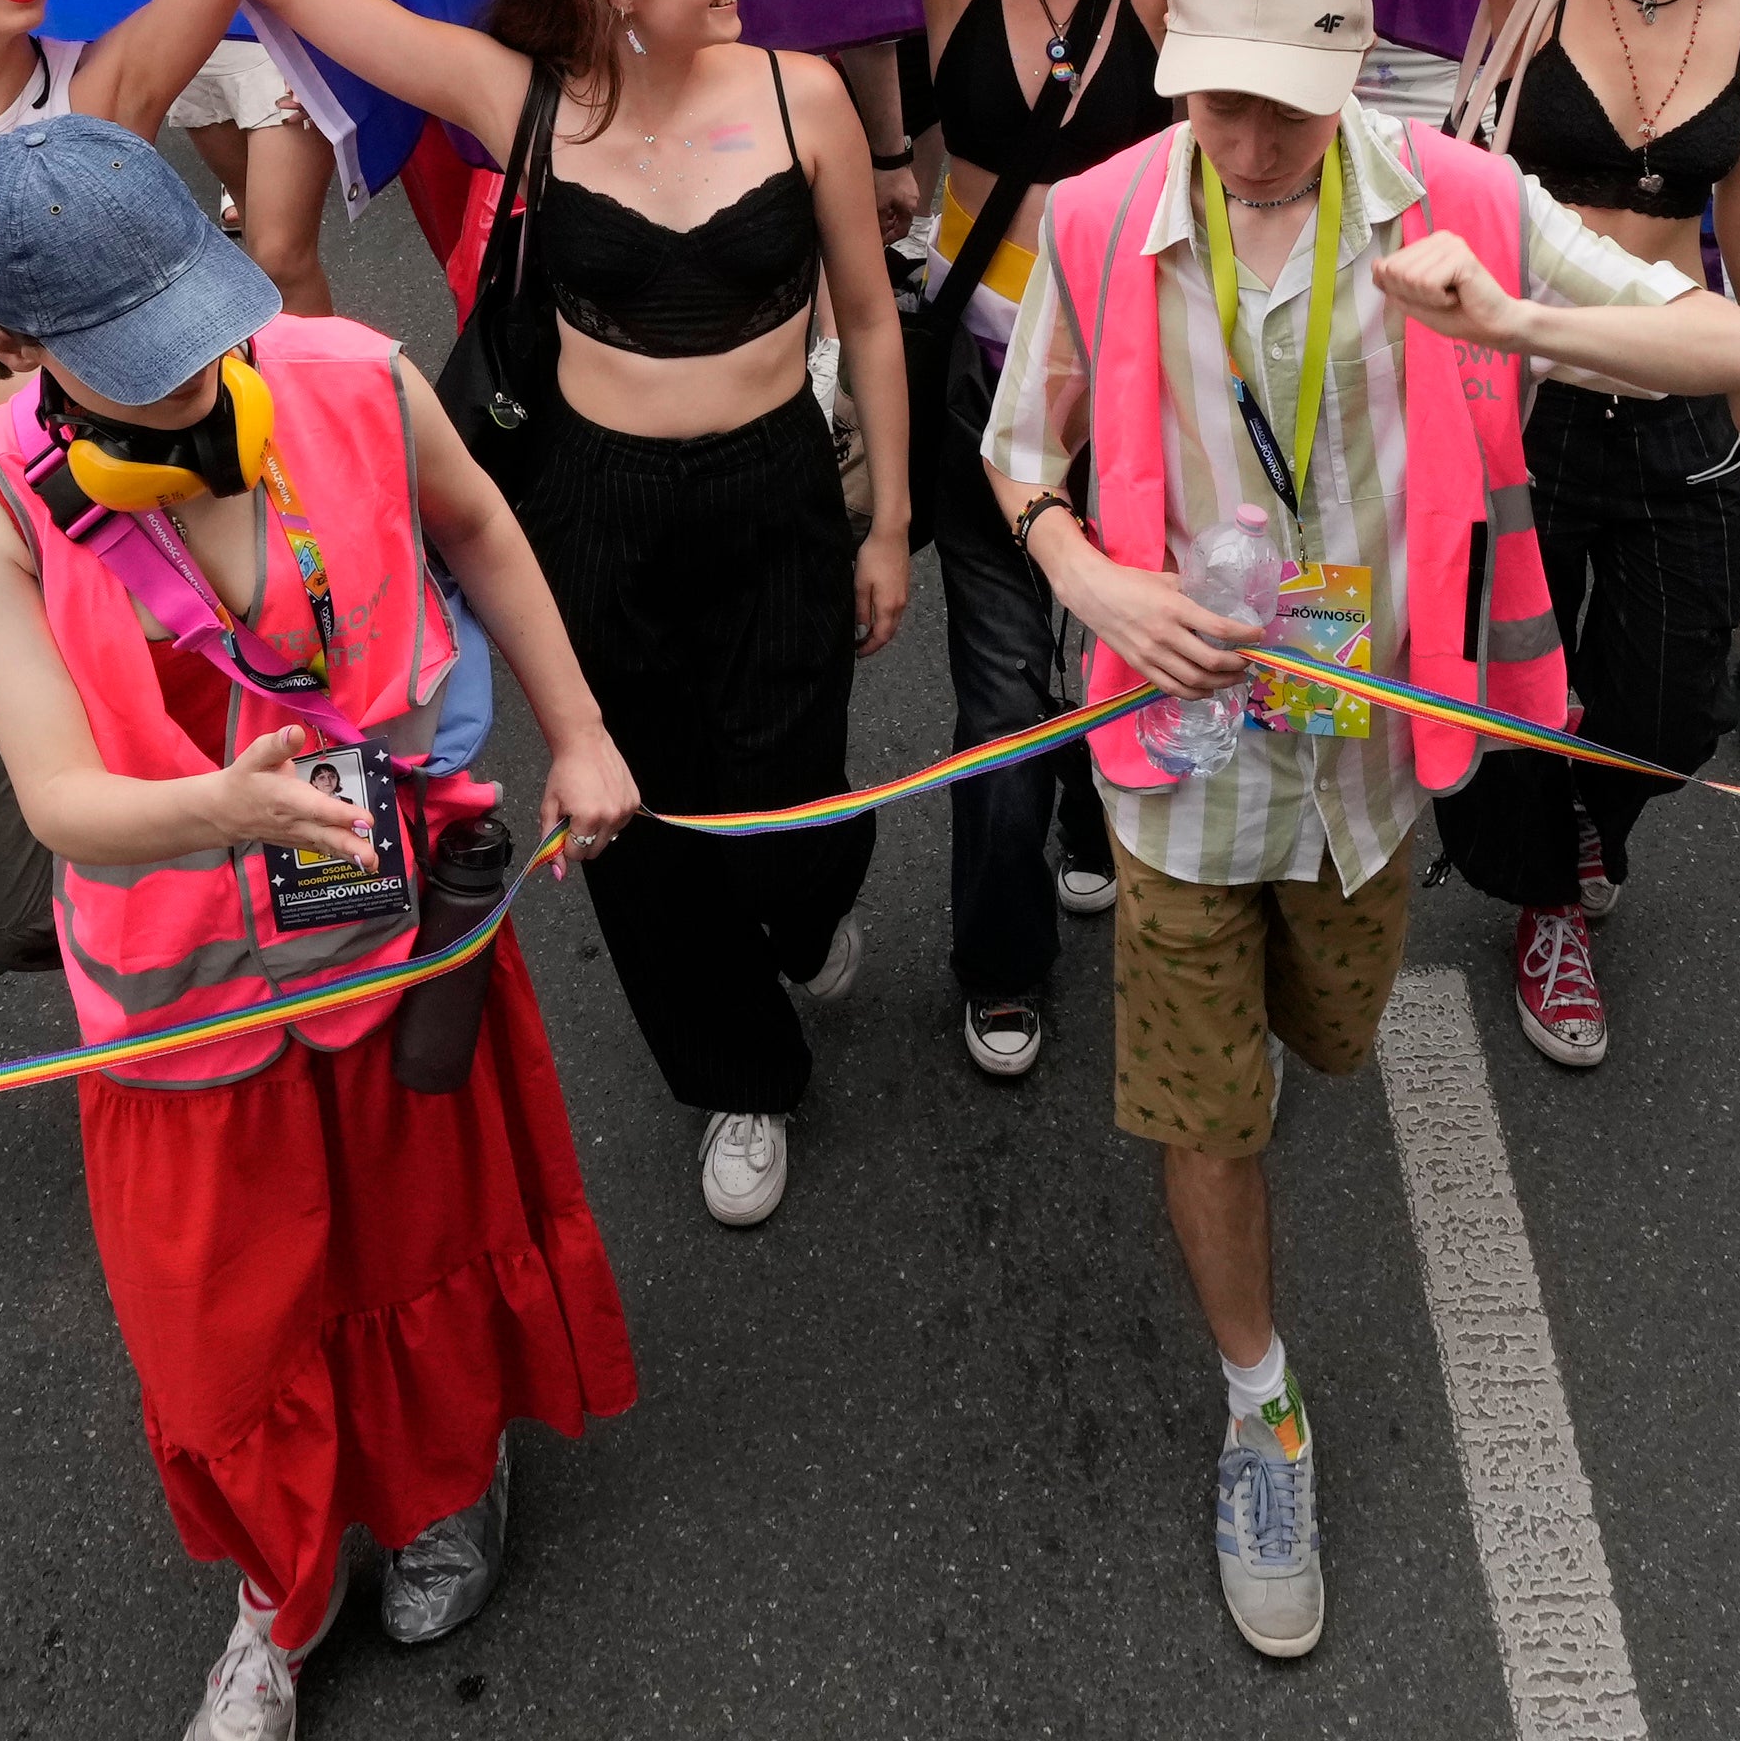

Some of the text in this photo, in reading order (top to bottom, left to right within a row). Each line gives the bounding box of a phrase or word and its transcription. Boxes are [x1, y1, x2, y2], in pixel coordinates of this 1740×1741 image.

[1314, 12, 1345, 33] 4F
[1291, 605, 1365, 623] RÓWNOŚCI
[322, 864, 353, 875] OSOBA
[285, 888, 328, 902] PARADA
[326, 877, 402, 900] RÓWNOŚCI
